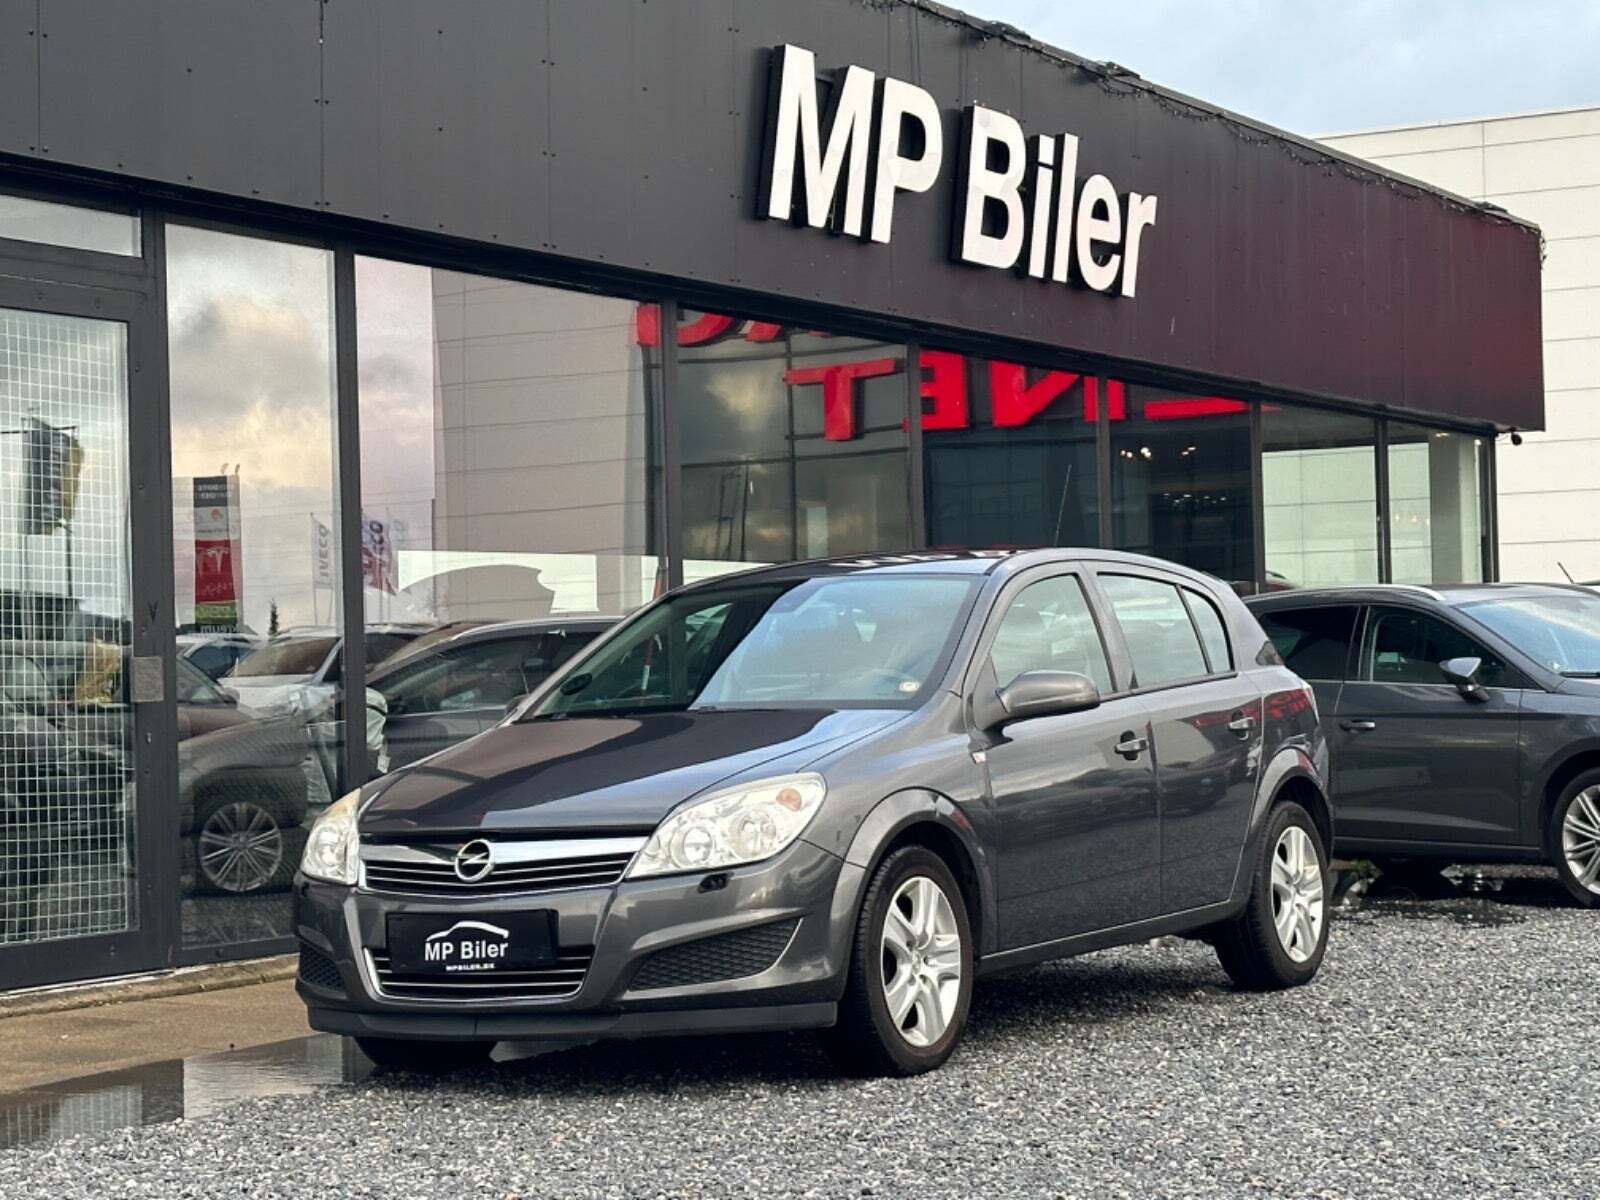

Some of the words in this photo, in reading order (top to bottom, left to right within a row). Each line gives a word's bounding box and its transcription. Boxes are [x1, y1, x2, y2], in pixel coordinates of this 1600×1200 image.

[767, 43, 943, 244] MP
[961, 103, 1158, 298] Biler
[318, 523, 330, 577] IVECO
[425, 942, 454, 961] MP
[461, 940, 509, 959] Biler
